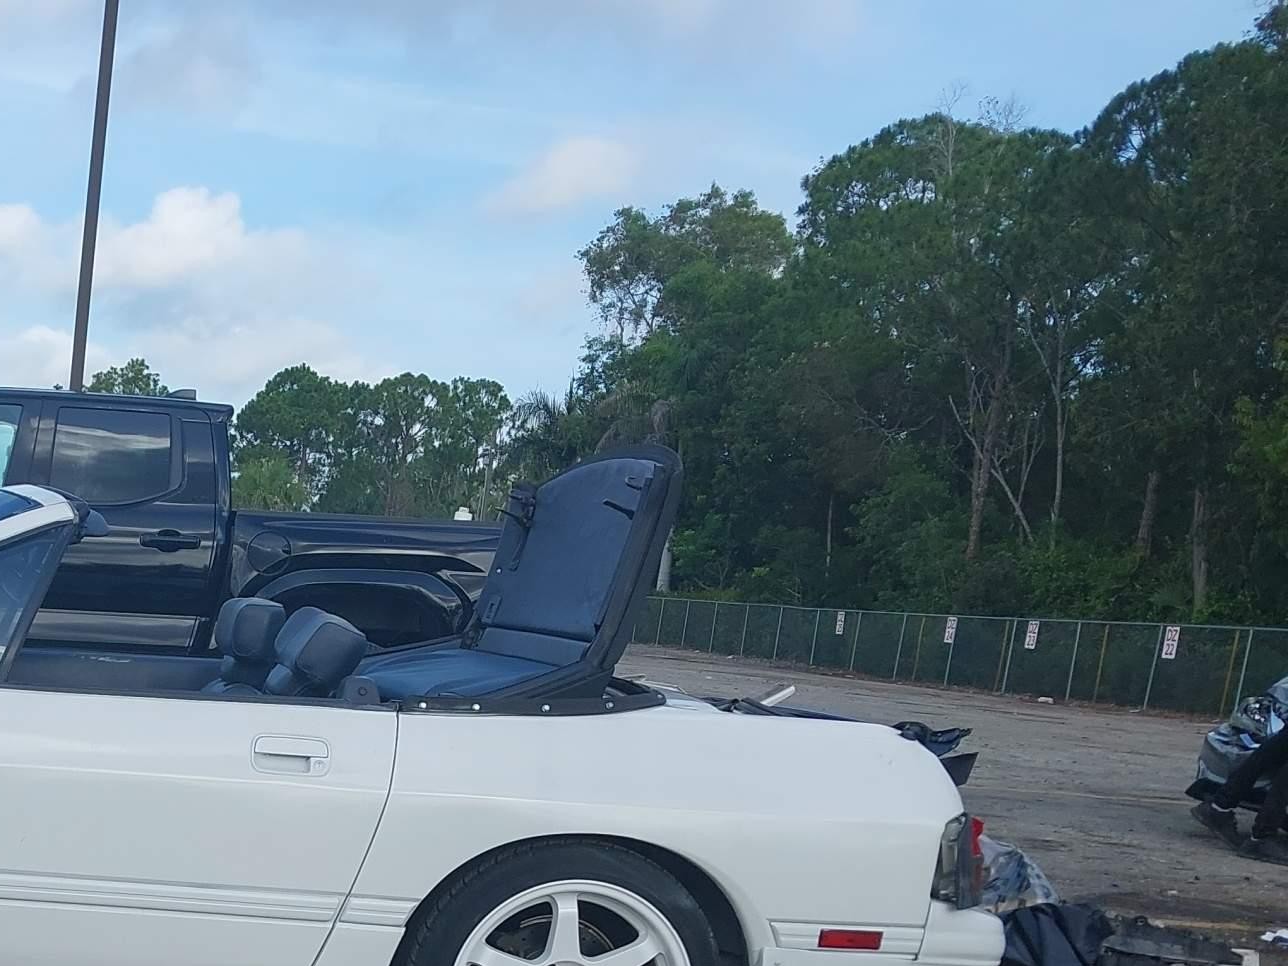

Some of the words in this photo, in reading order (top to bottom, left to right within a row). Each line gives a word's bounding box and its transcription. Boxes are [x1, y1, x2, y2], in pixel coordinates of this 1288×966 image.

[946, 618, 957, 630] DZ
[1027, 622, 1039, 635] DZ
[1166, 628, 1179, 642] DZ
[1164, 642, 1175, 656] 22
